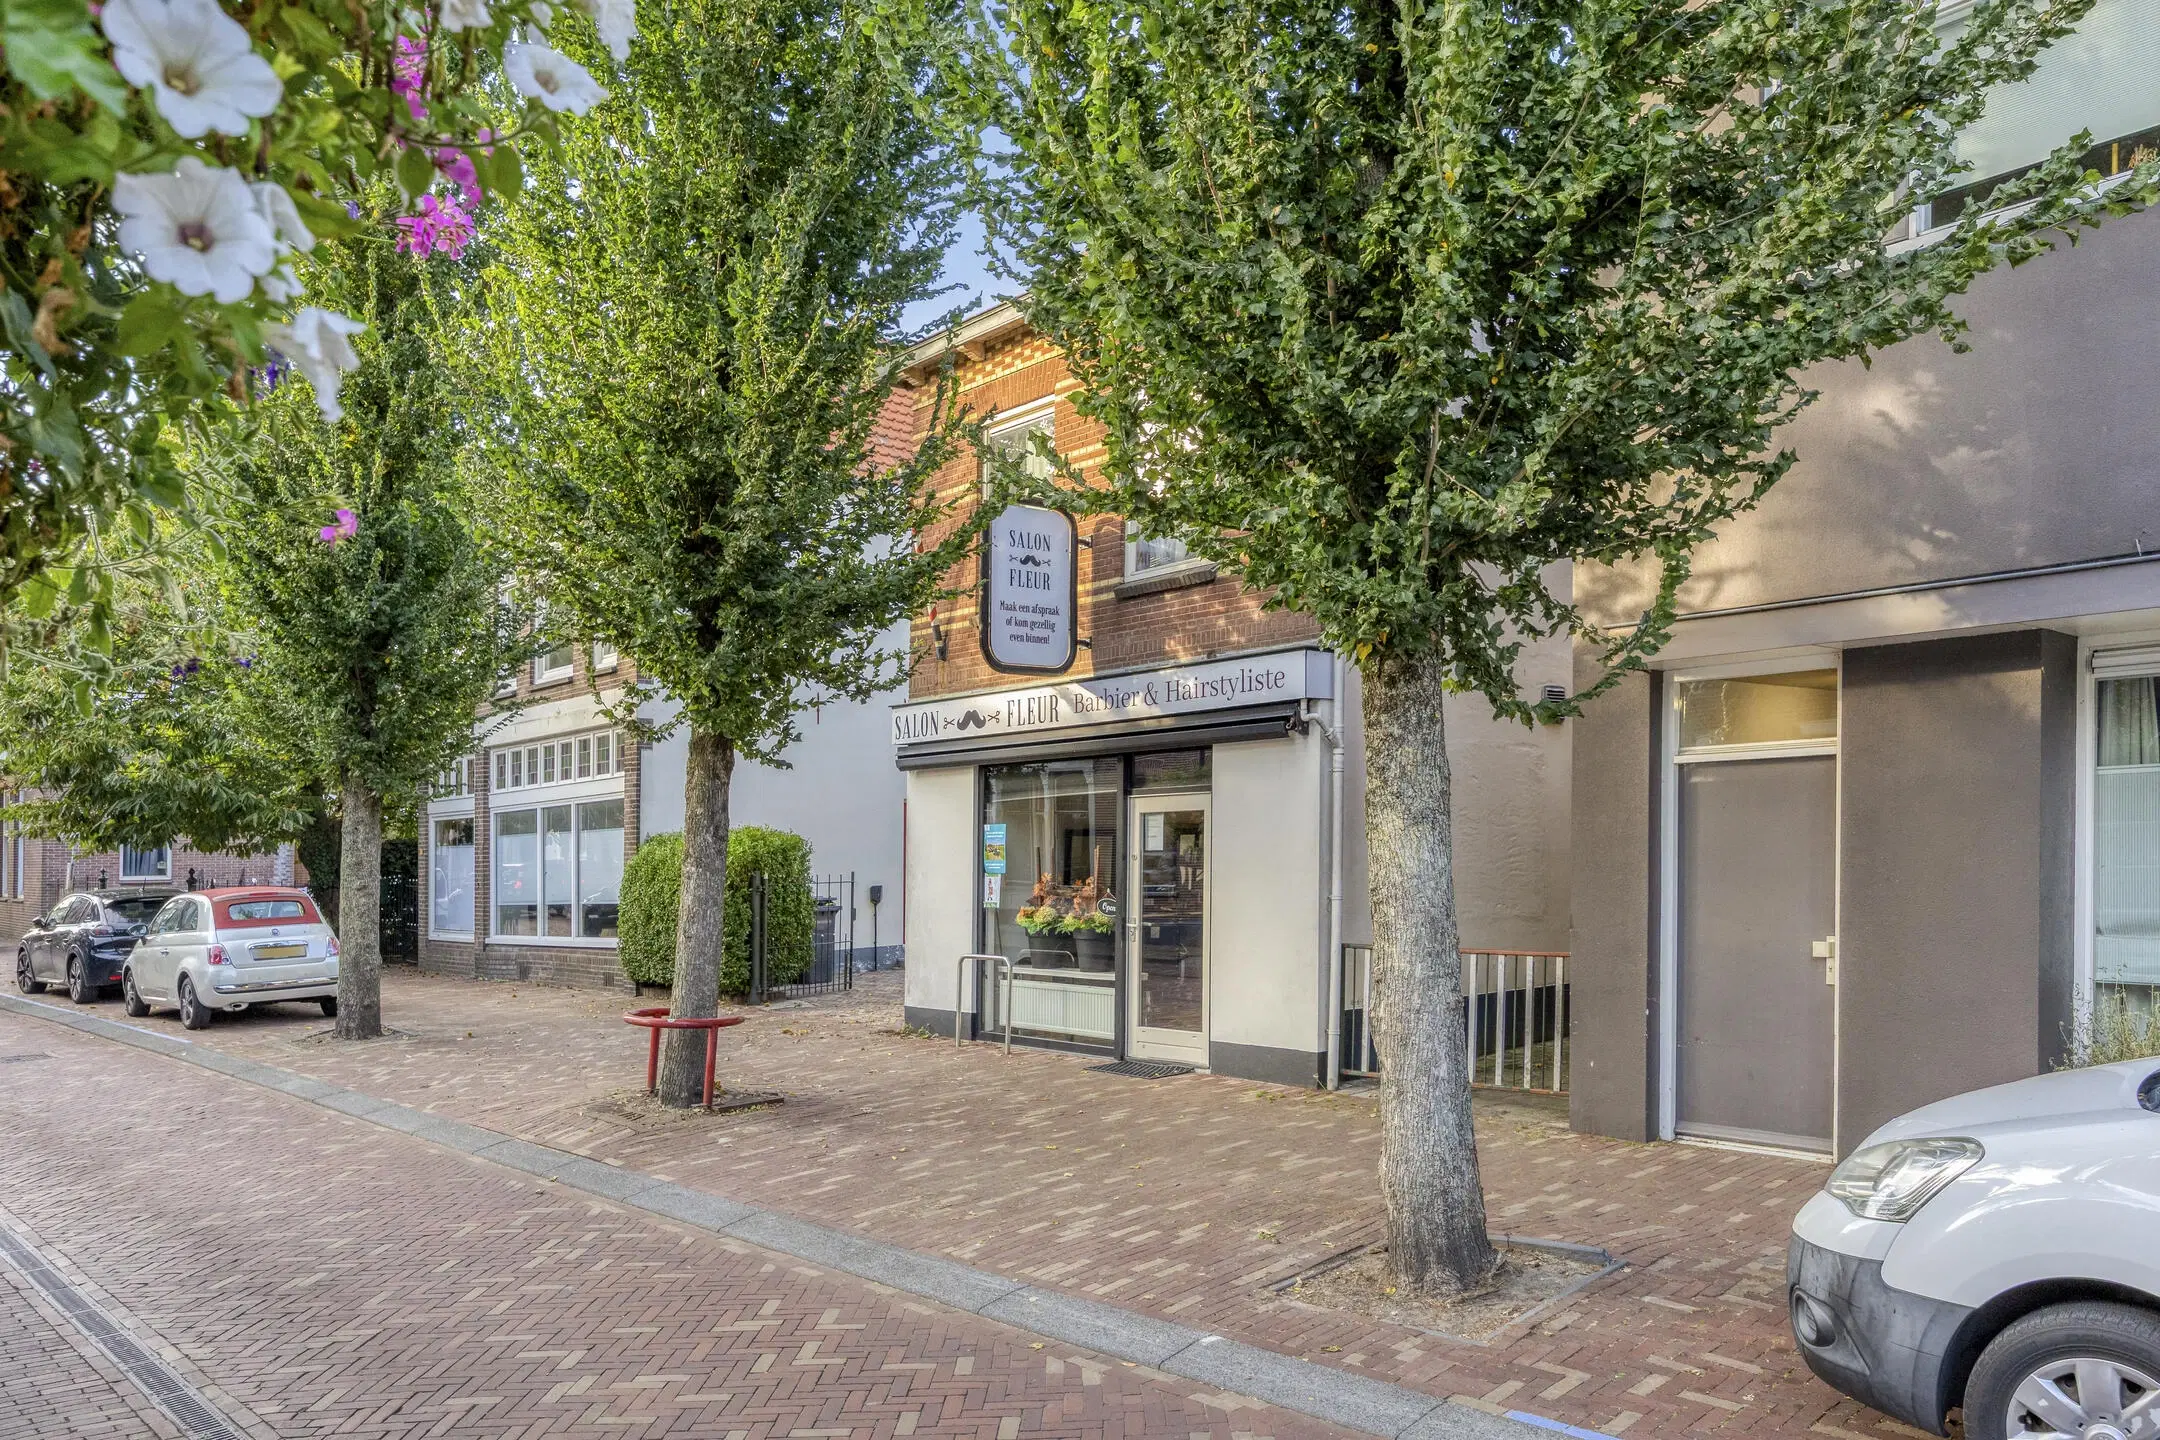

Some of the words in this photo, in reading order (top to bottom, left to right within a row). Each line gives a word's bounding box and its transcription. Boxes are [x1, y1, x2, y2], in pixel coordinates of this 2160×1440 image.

[1009, 530, 1051, 552] SALON
[1009, 569, 1051, 591] FLEUR
[1000, 600, 1018, 613] Maak
[1018, 604, 1031, 613] een
[1031, 604, 1060, 617] afspraak
[1005, 616, 1013, 626] of
[1014, 616, 1029, 628] kom
[1029, 618, 1056, 633] gezellig
[1009, 633, 1026, 643] even
[1025, 632, 1050, 645] binnen!
[895, 710, 940, 740] SALON
[1007, 694, 1060, 727] FLEUR
[1073, 688, 1140, 714] Barbier
[1144, 681, 1159, 706] &
[1165, 668, 1286, 702] Hairstyliste
